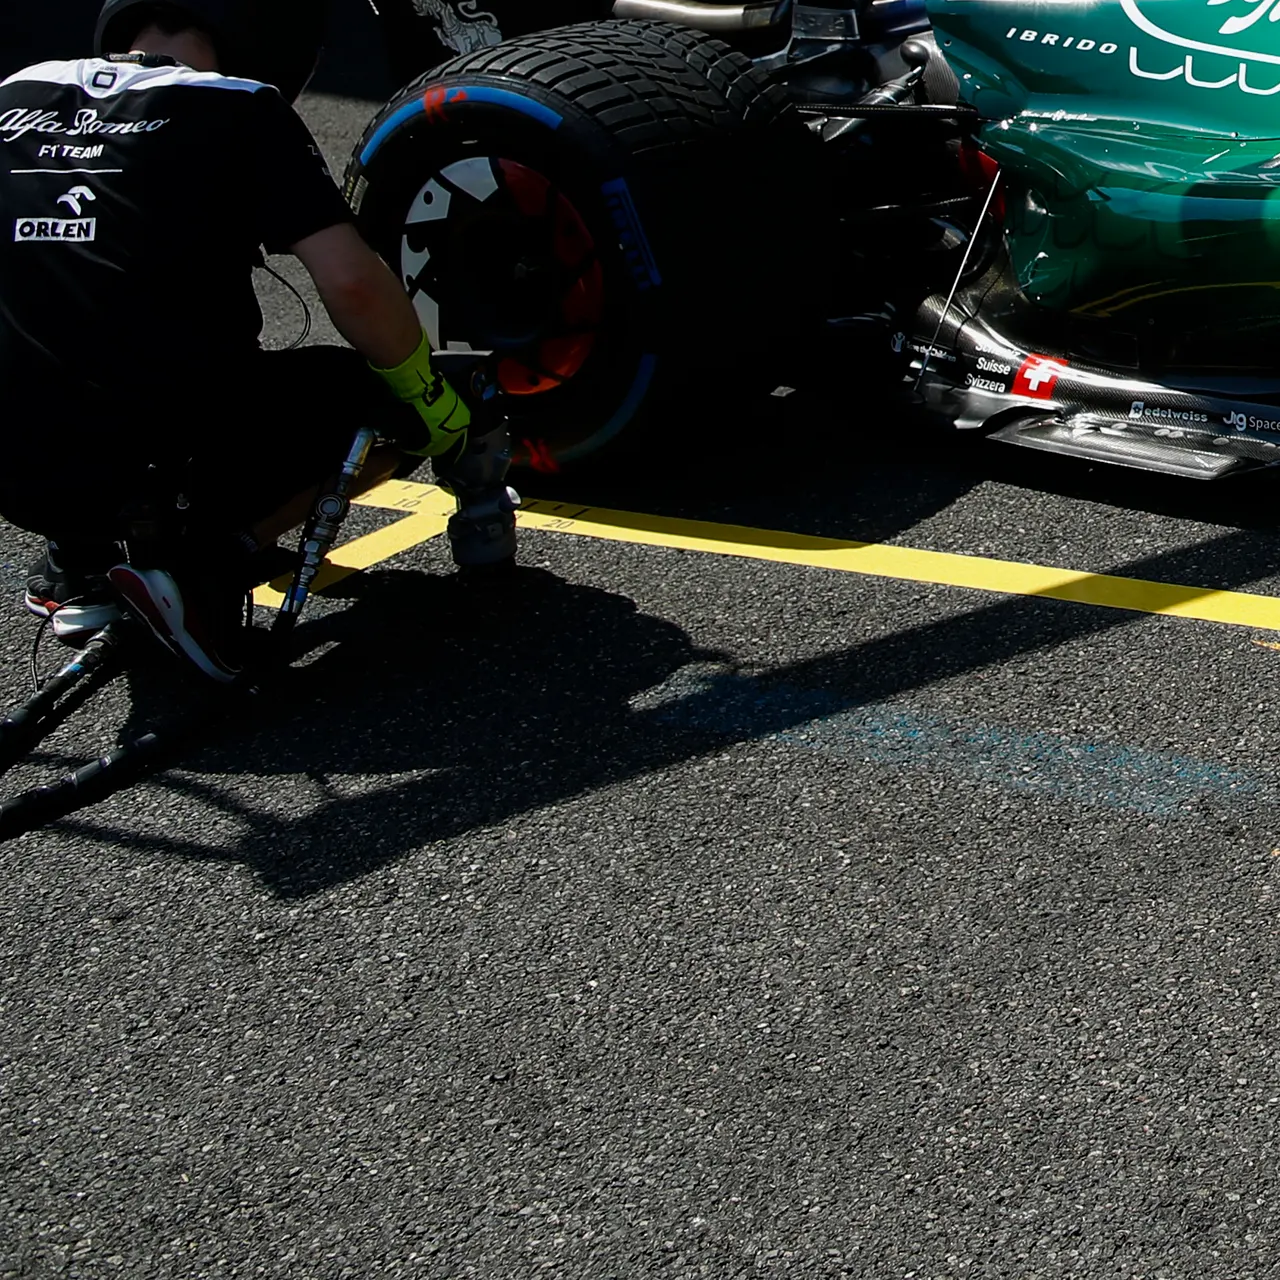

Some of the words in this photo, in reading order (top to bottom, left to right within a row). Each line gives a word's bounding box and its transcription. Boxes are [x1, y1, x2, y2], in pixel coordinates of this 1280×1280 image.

[1006, 27, 1118, 54] IBRIDO
[0, 108, 67, 143] Alfa
[66, 108, 170, 136] Romeo
[38, 145, 58, 159] F1
[62, 143, 105, 160] TEAM
[19, 222, 92, 239] ORLEN
[976, 357, 1011, 376] Suisse
[964, 373, 1006, 393] Svizzera
[1144, 406, 1208, 423] edelweiss
